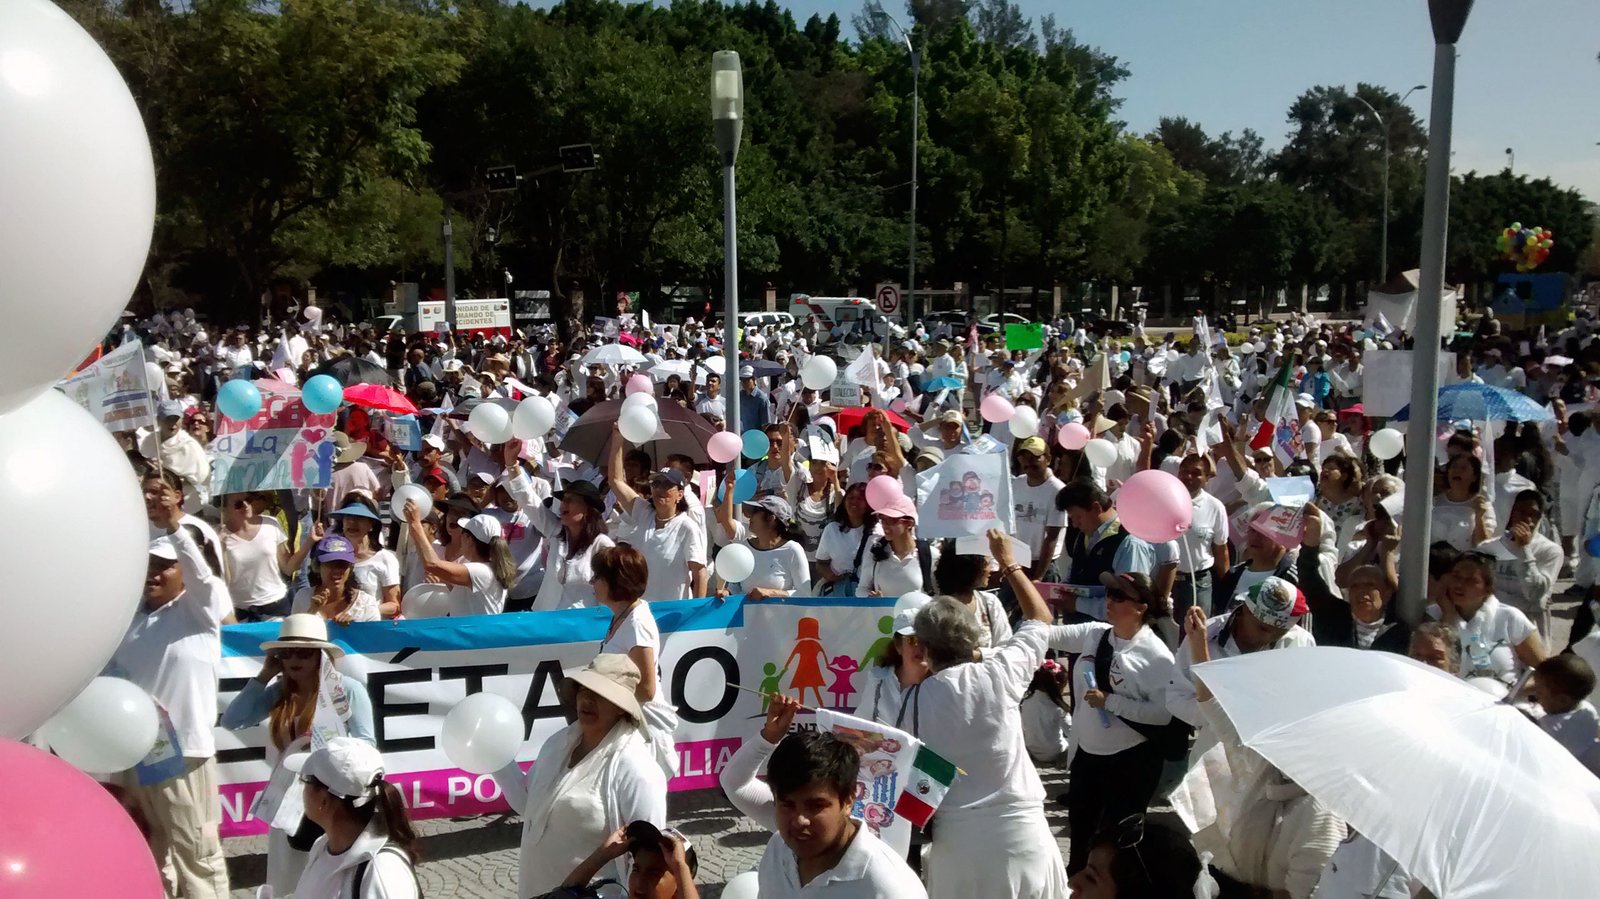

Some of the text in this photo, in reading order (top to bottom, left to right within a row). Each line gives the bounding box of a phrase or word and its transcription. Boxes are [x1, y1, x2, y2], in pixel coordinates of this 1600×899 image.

[245, 432, 278, 454] La
[788, 723, 818, 737] ENT
[447, 774, 502, 805] PO
[672, 746, 732, 778] ILIA
